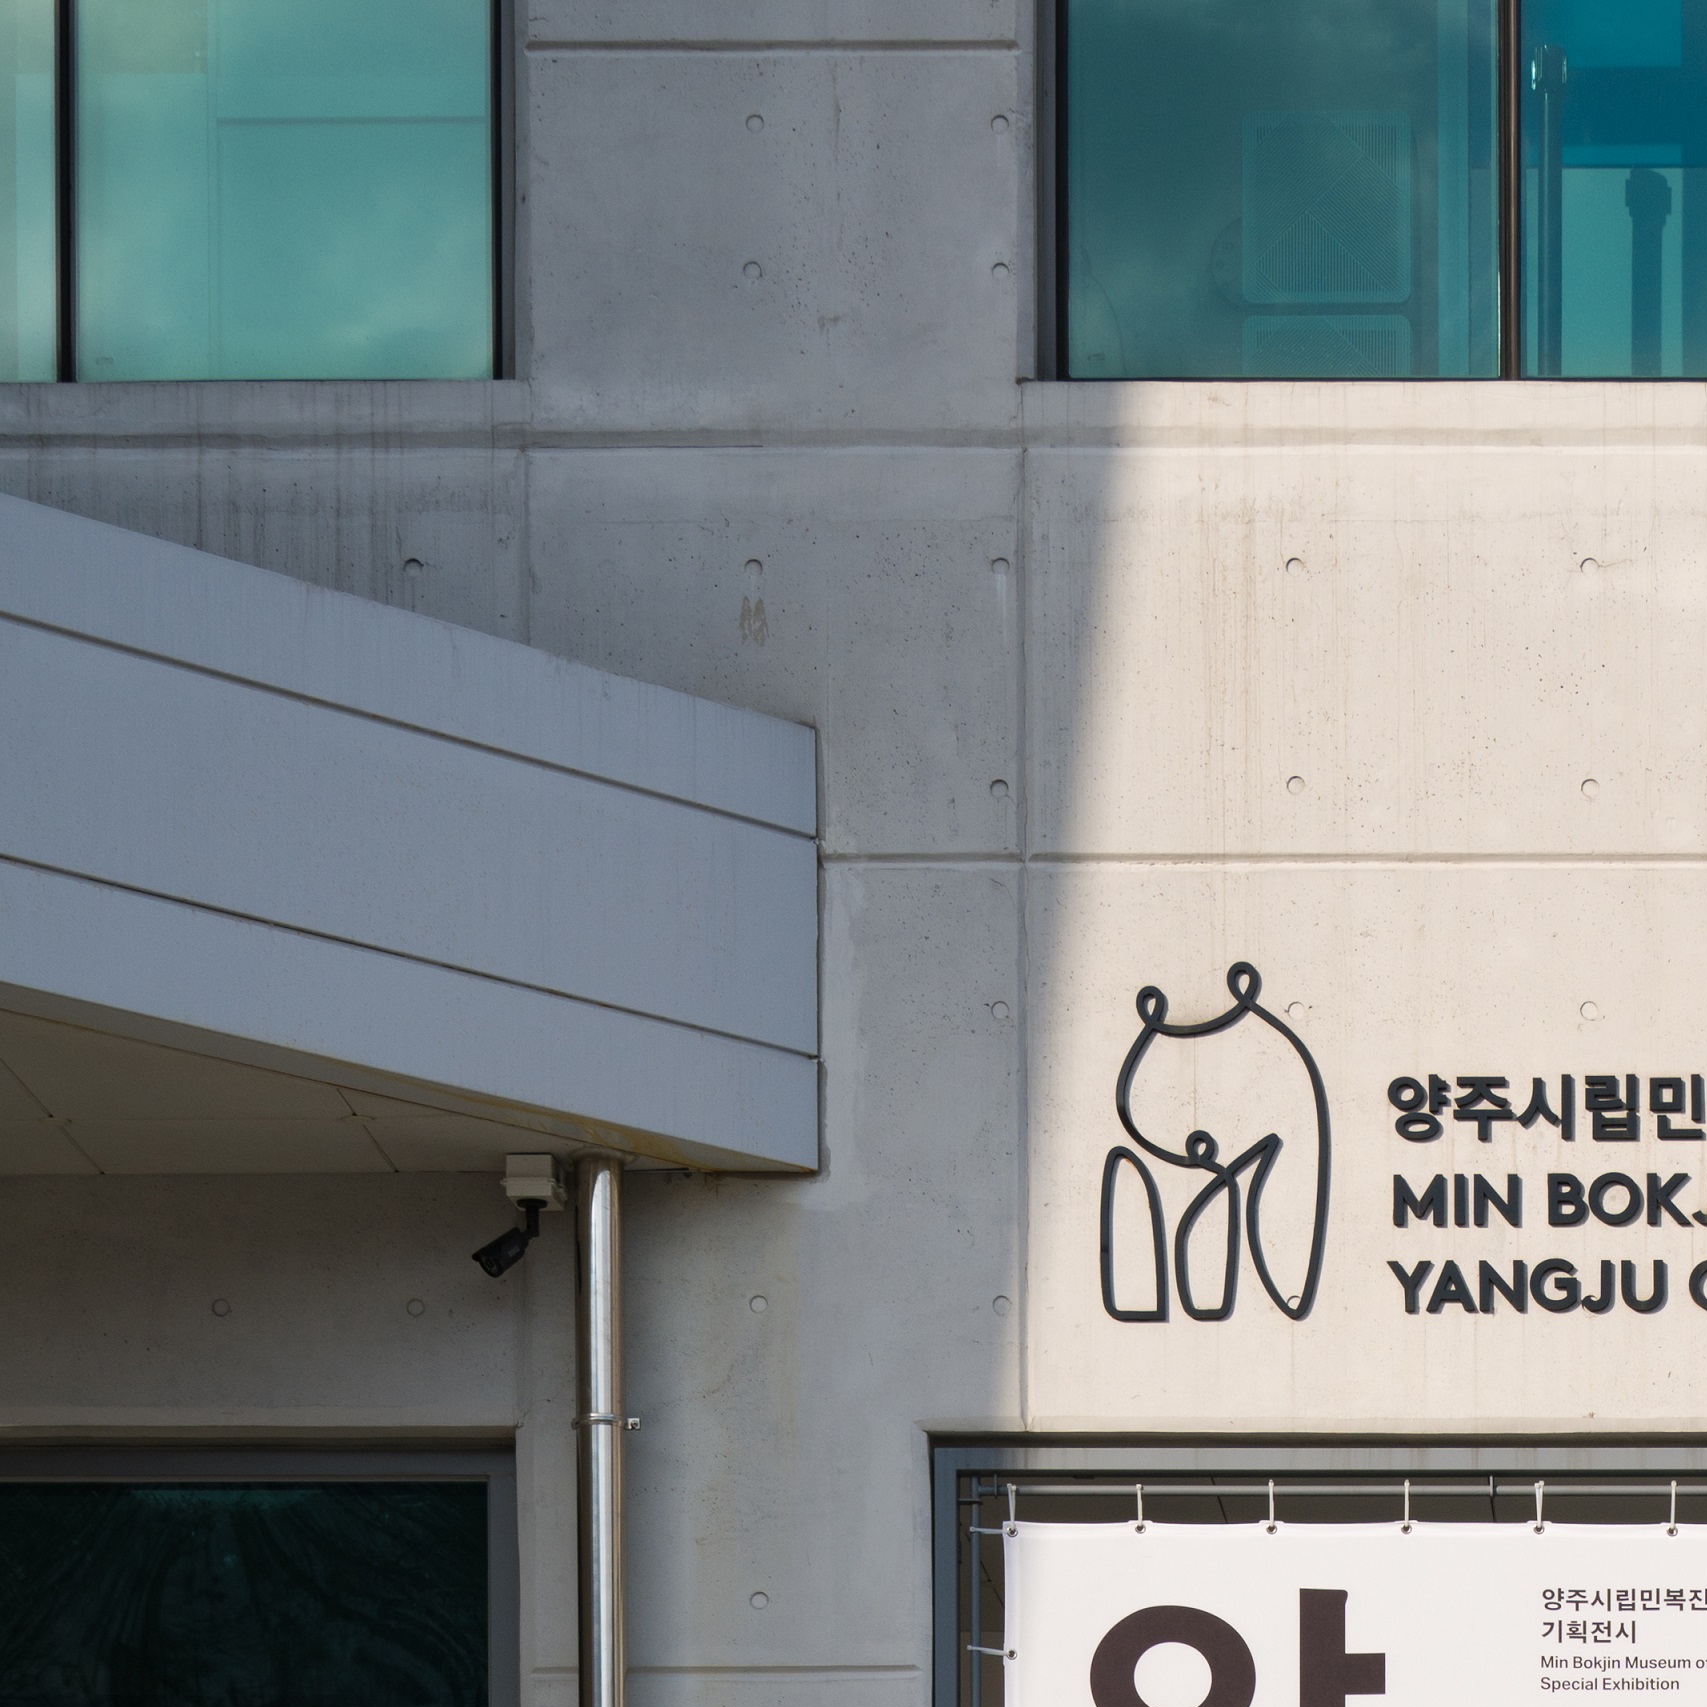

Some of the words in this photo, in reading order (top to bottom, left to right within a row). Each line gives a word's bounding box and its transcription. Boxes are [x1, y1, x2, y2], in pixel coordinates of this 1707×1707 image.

[1393, 1174, 1521, 1228] MIN
[1387, 1259, 1667, 1314] YANGJU
[1542, 1620, 1635, 1643] 기획전시
[1540, 1655, 1569, 1669] Min
[1573, 1655, 1621, 1673] Bokjin
[1625, 1656, 1691, 1669] Museum
[1540, 1676, 1598, 1693] Special
[1602, 1677, 1680, 1691] Exhibition
